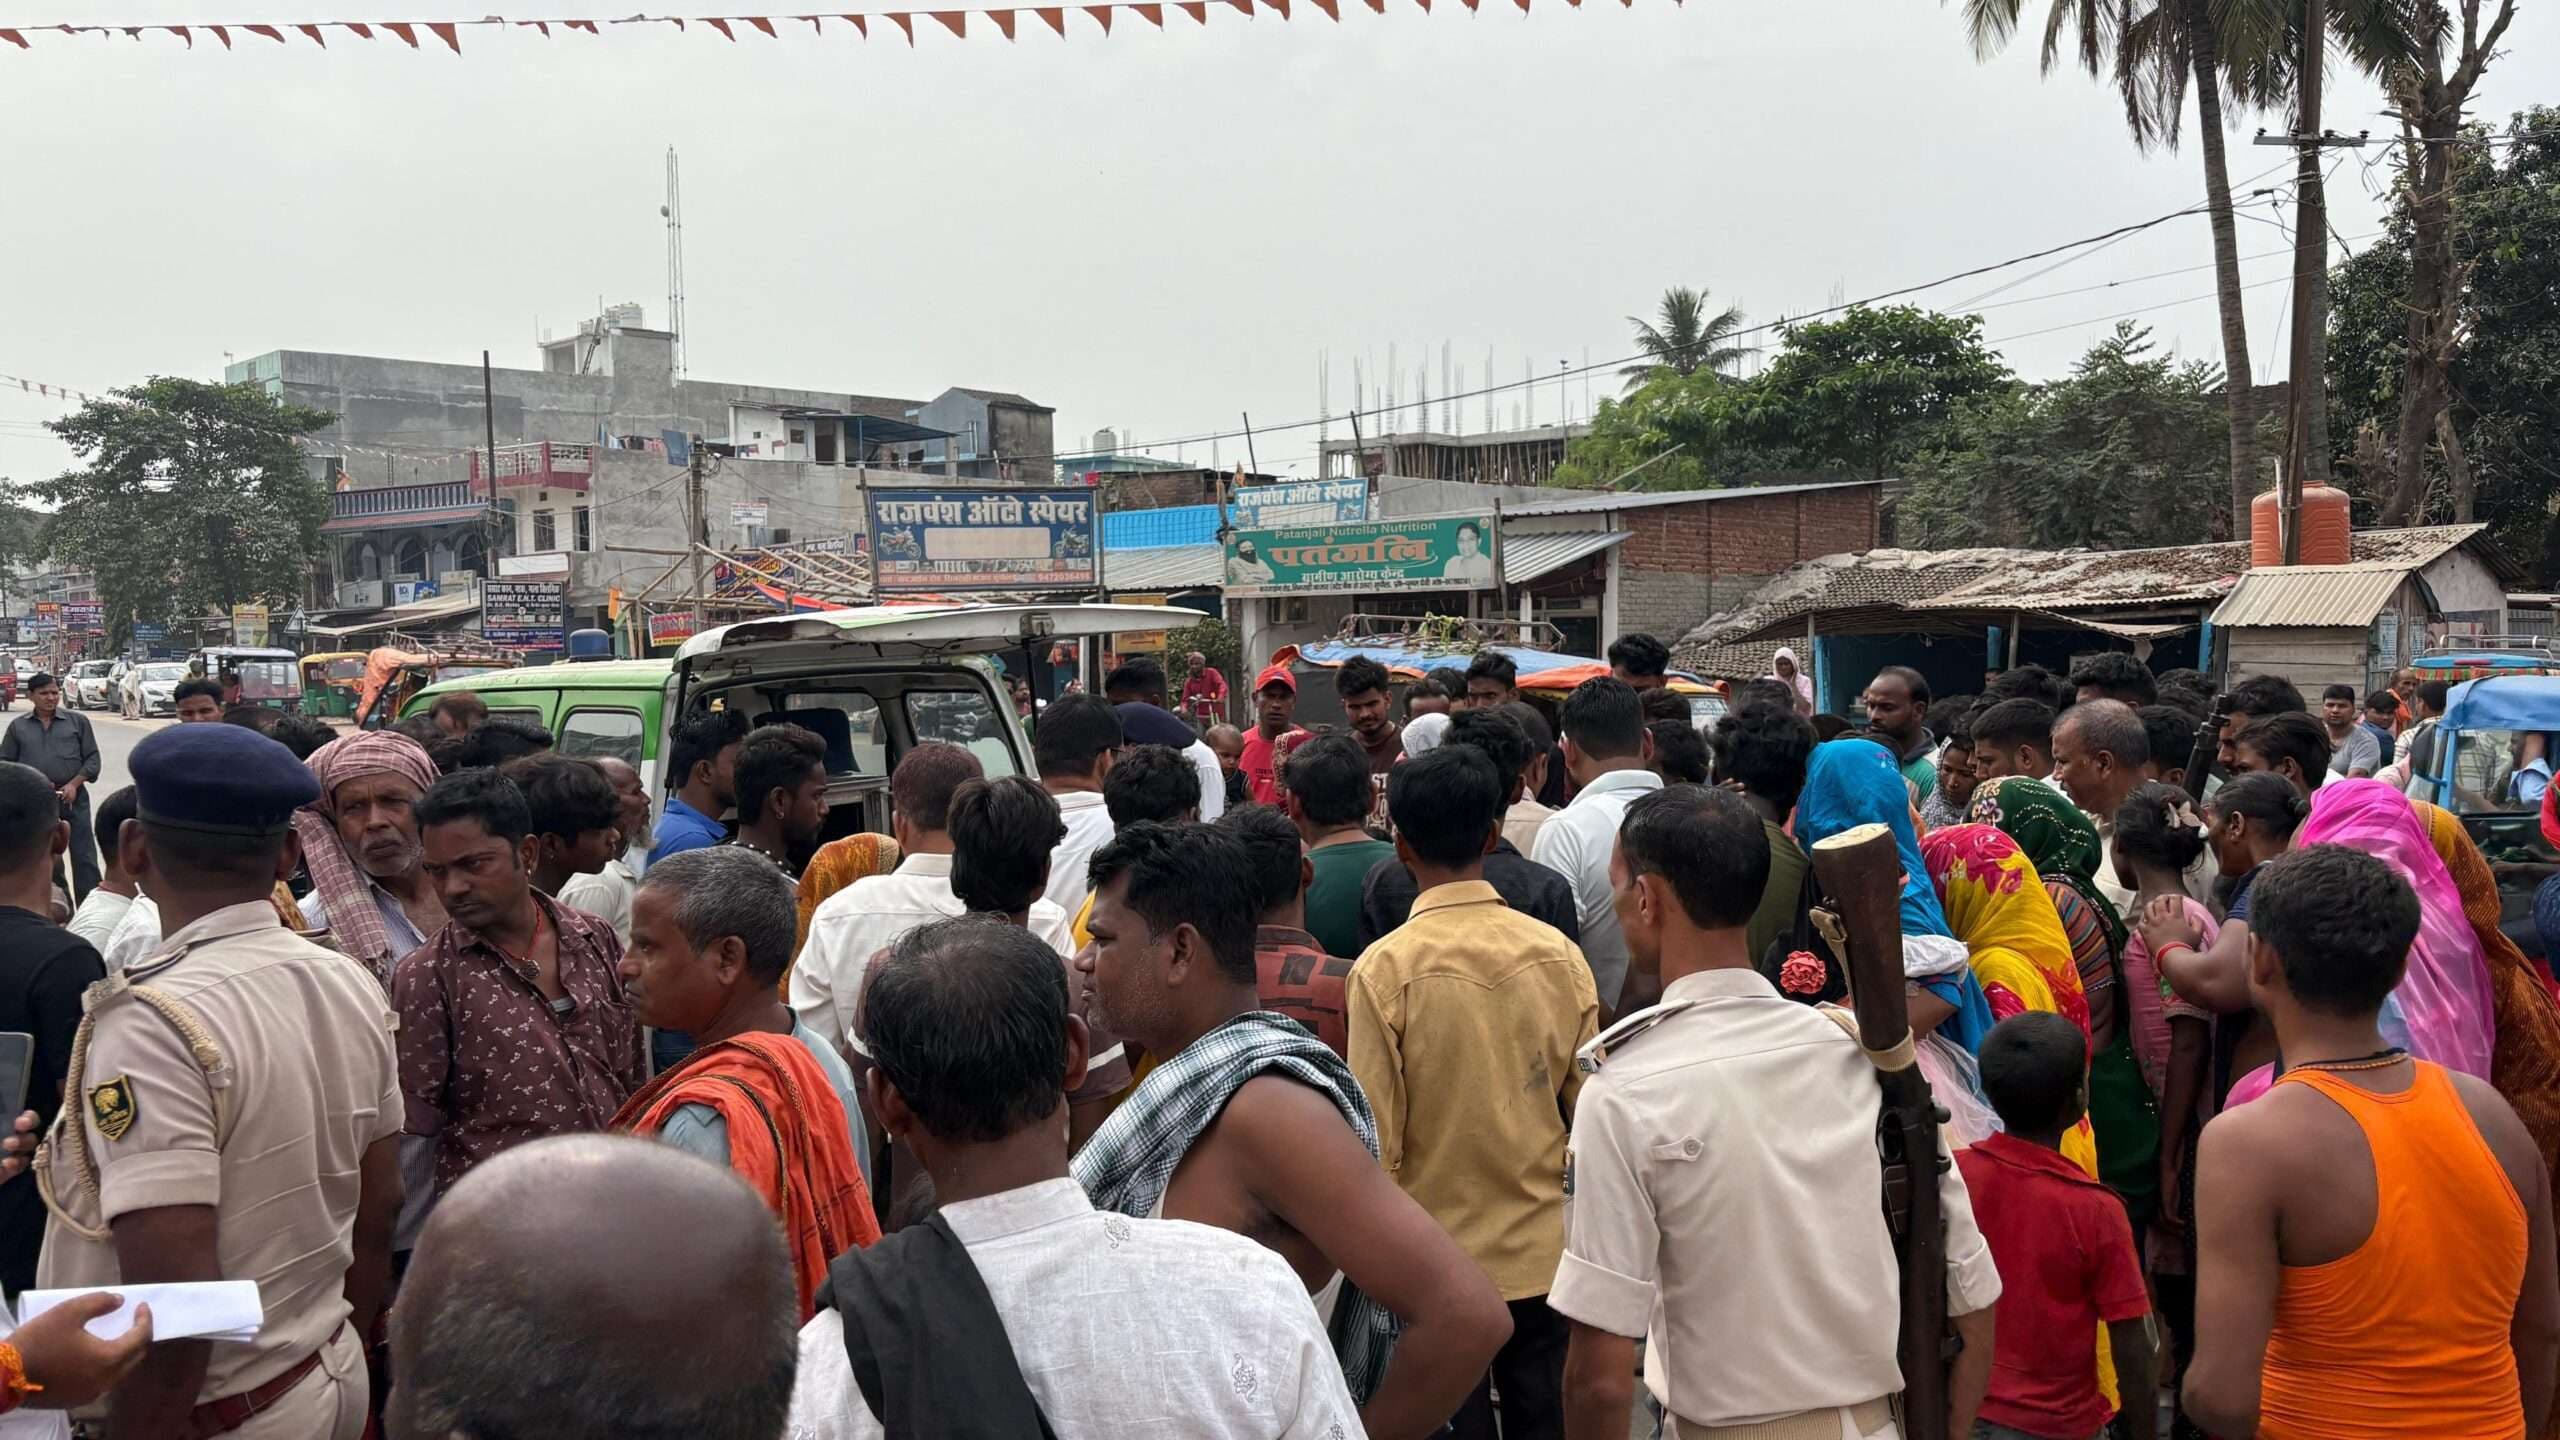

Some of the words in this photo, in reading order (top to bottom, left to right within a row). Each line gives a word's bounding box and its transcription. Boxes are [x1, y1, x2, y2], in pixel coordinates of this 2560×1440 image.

[1287, 483, 1321, 504] ऑटो
[1324, 482, 1364, 501] स्पेयर
[876, 496, 963, 525] राजवंश
[967, 495, 1024, 525] ऑटो
[1028, 495, 1089, 524] स्पेयर
[1275, 529, 1326, 541] Patanjali
[1381, 521, 1437, 534] Nutrition
[1268, 535, 1434, 566] पतंजलि
[1341, 567, 1378, 581] आरोग्य
[1380, 566, 1405, 580] केन्द्र
[487, 594, 515, 602] SAMRAT
[517, 594, 536, 602] E.N.T.
[538, 594, 560, 602] CLINIC
